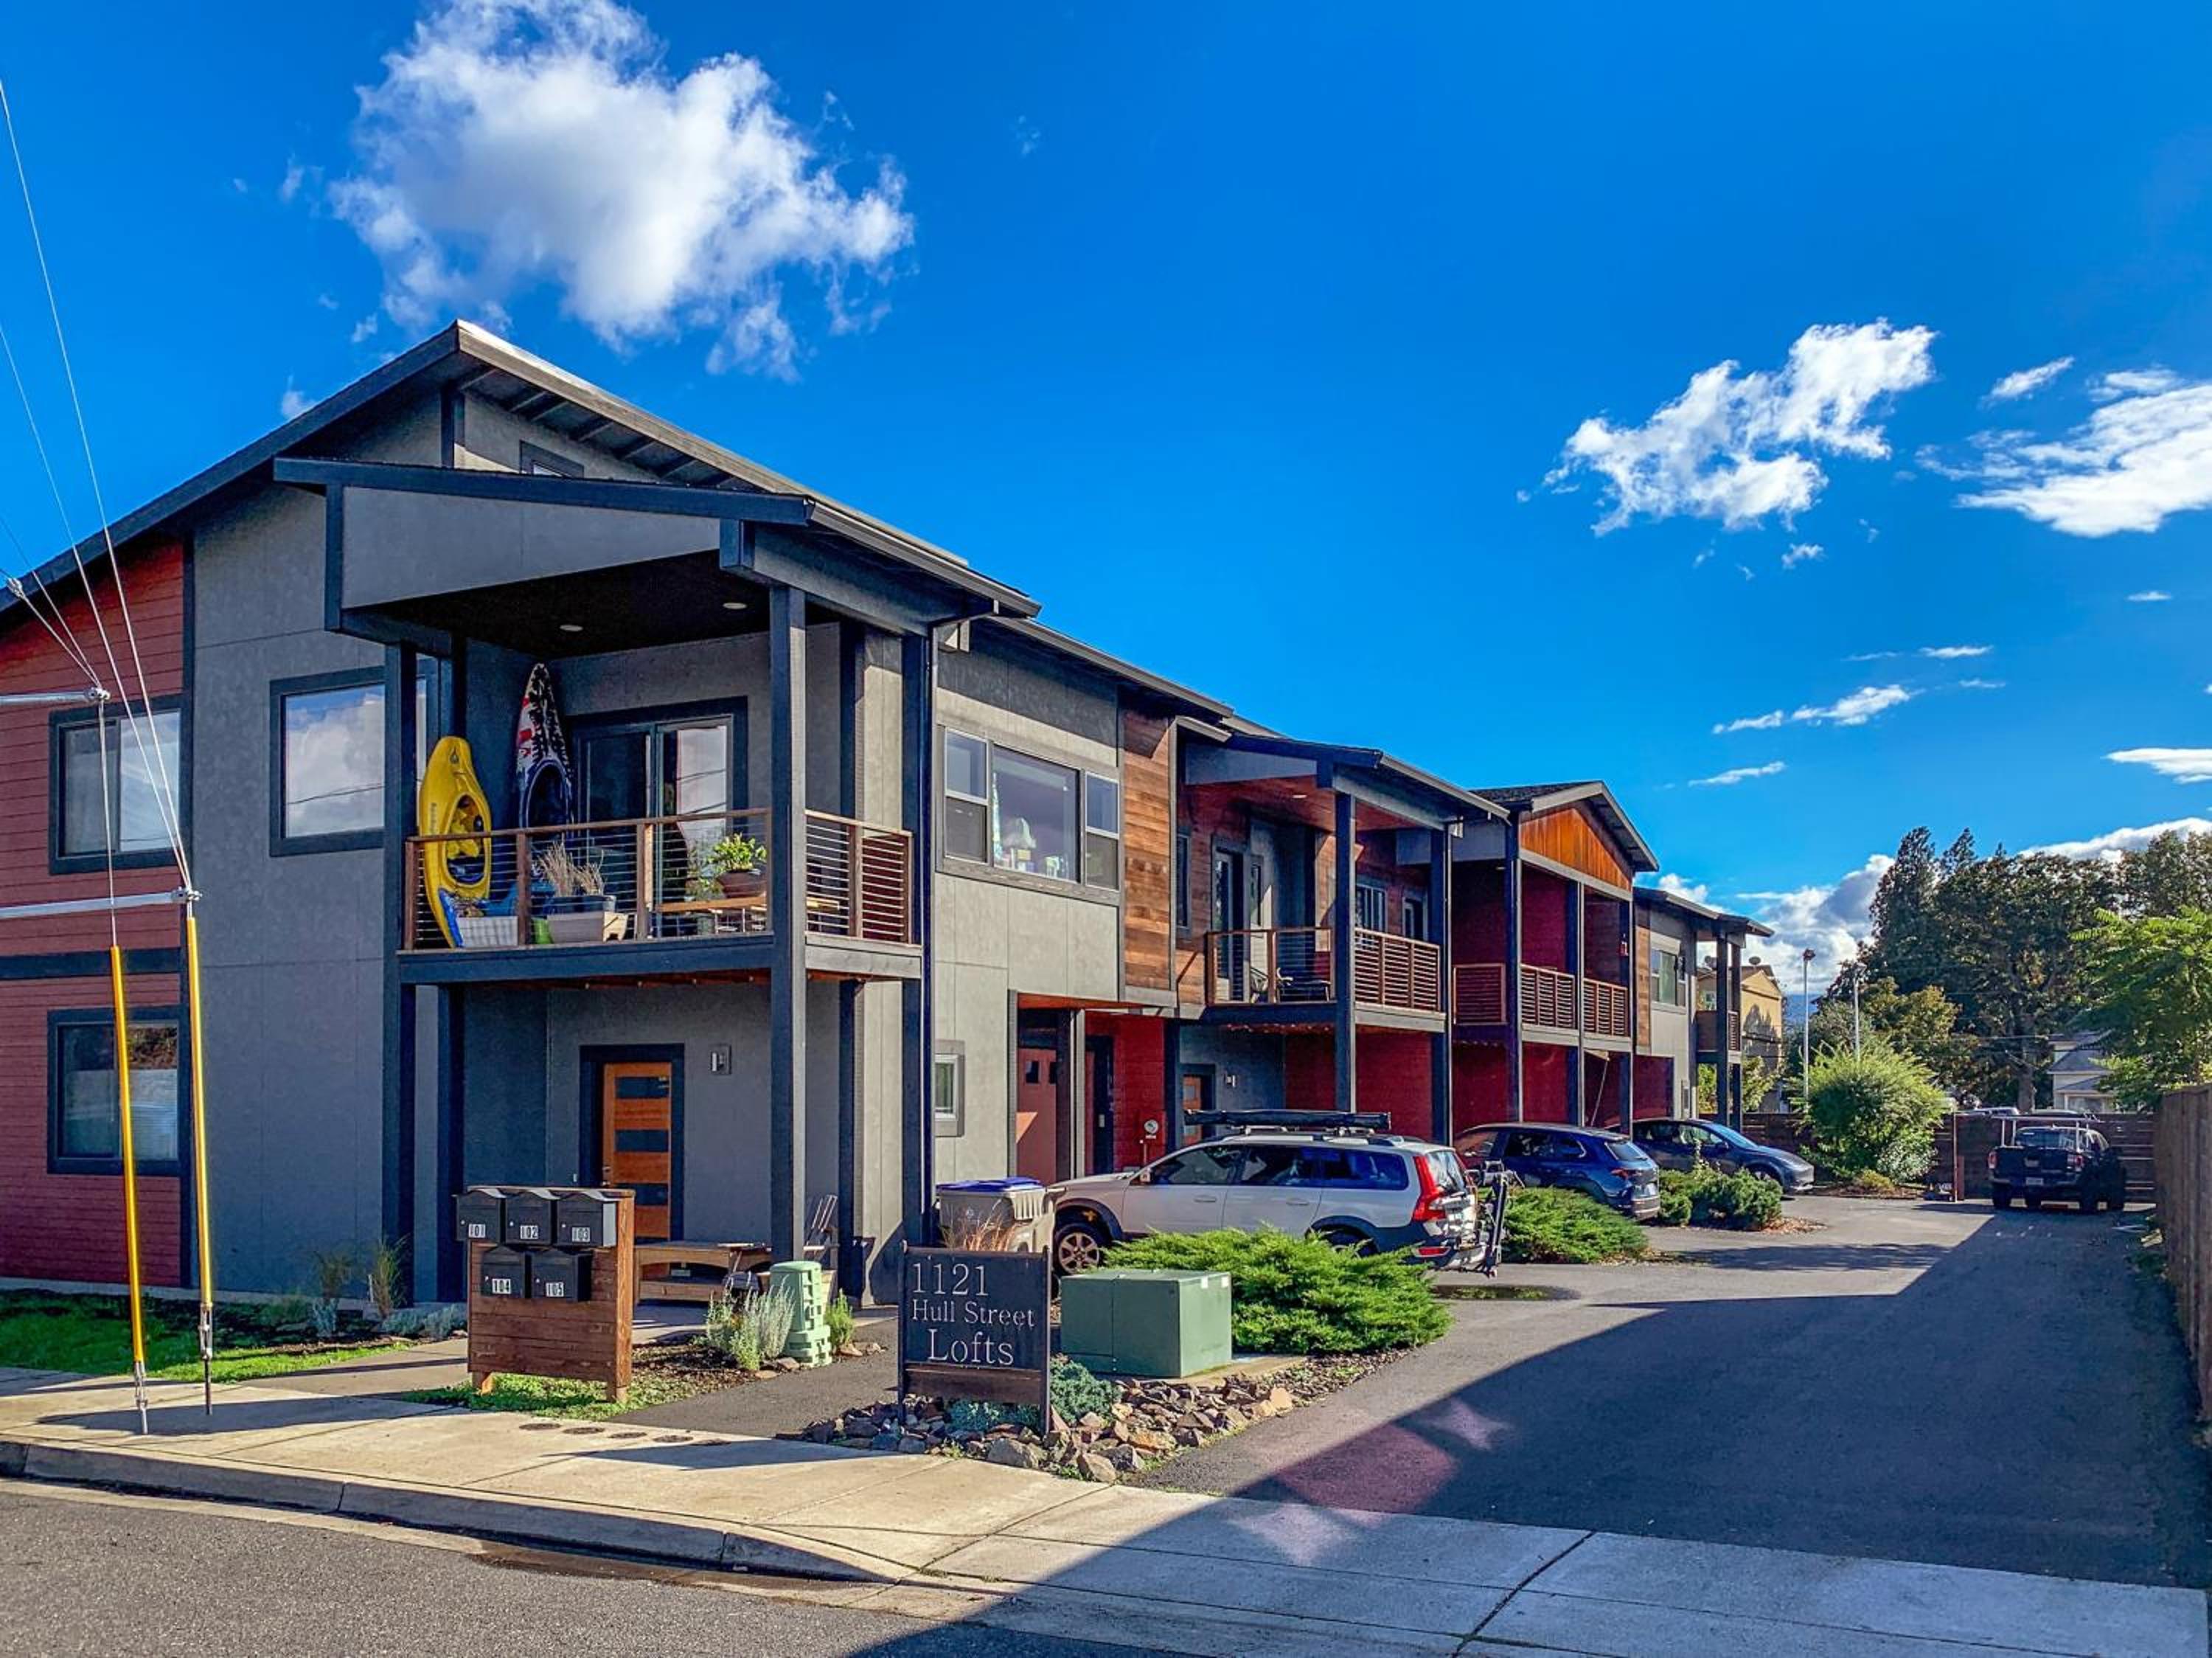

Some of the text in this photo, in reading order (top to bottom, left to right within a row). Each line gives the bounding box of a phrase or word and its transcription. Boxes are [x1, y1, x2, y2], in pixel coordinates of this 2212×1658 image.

[470, 1224, 485, 1237] 101
[520, 1226, 538, 1238] 102
[572, 1227, 589, 1241] 103
[493, 1280, 509, 1292] 104
[912, 1263, 989, 1296] 1121
[546, 1282, 563, 1296] 105
[912, 1299, 1034, 1328] Hull Street
[928, 1328, 1014, 1365] Lofts
